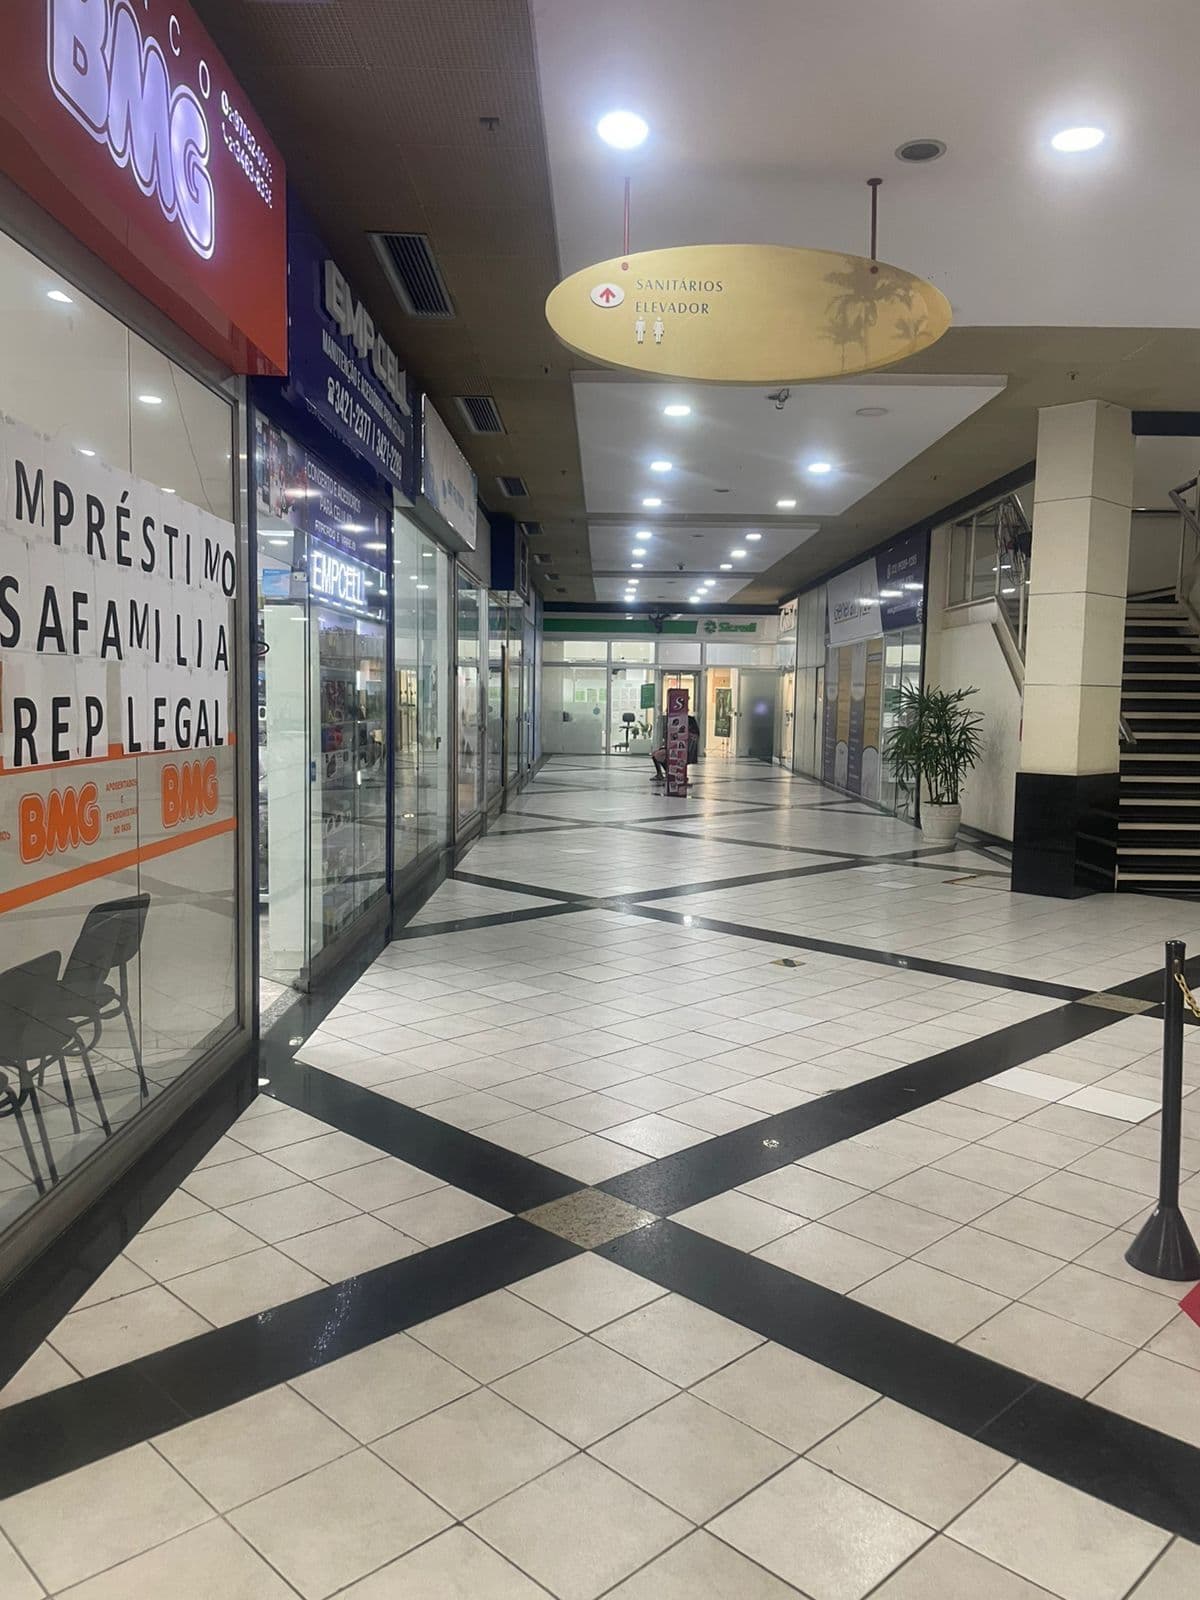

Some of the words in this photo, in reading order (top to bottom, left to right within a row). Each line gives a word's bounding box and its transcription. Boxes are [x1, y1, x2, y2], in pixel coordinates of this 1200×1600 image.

[46, 0, 215, 259] BMG
[635, 301, 710, 315] ELEVADOR
[636, 277, 724, 293] SANITÁRIOS
[334, 380, 371, 445] 3421-2377
[13, 696, 104, 767] REP
[127, 696, 224, 753] LEGAL
[19, 782, 101, 864] BMG
[161, 757, 219, 828] BMG
